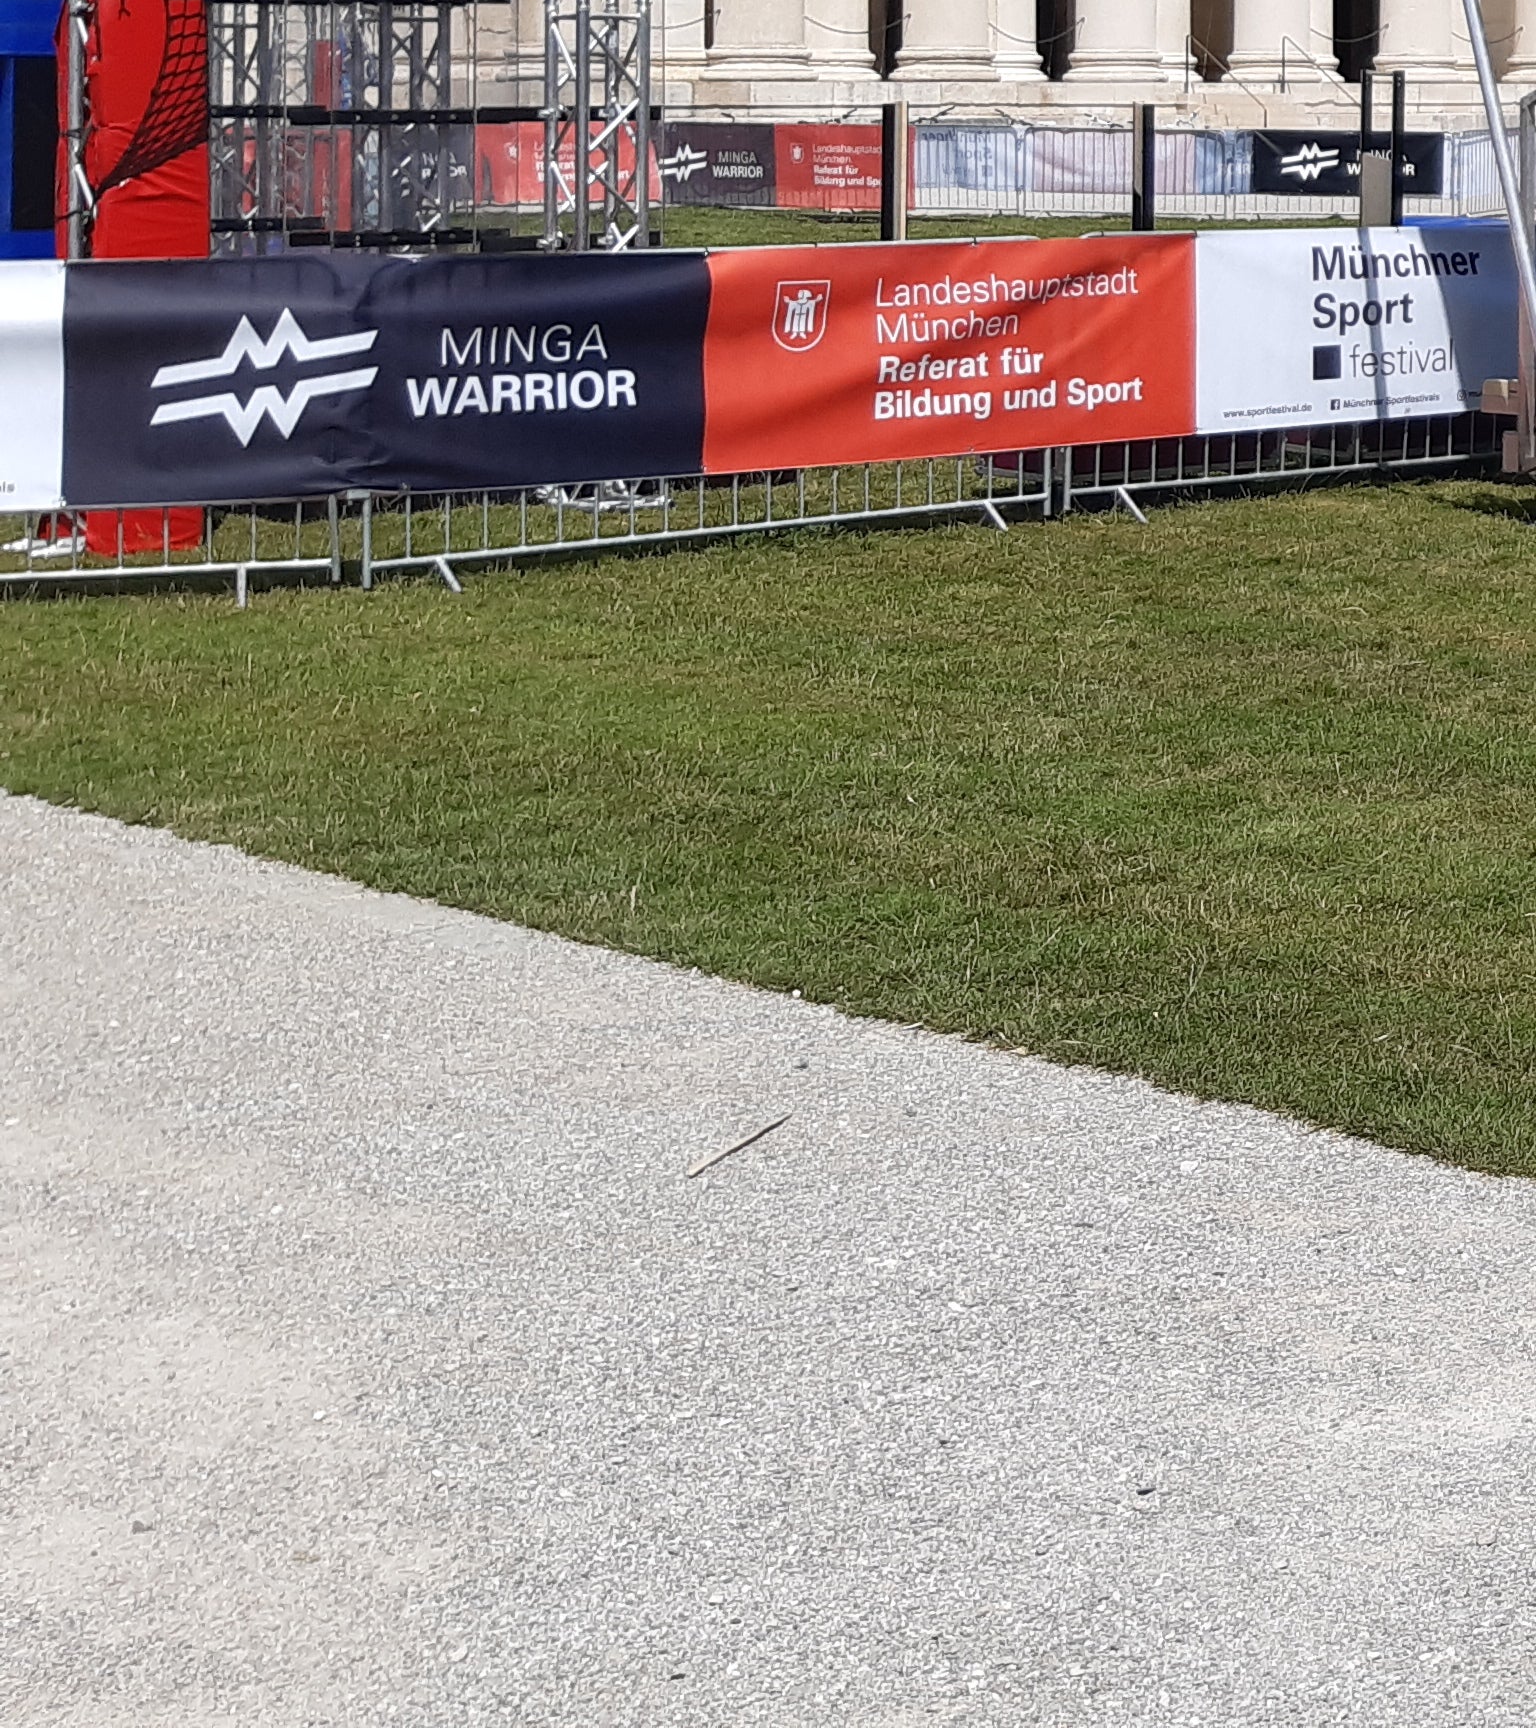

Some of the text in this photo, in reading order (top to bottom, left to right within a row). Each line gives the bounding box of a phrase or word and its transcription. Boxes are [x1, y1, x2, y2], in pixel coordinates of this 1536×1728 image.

[712, 165, 764, 178] WARRIOR
[718, 150, 757, 164] MINGA
[1311, 244, 1480, 281] Münchner
[875, 266, 1138, 307] Landeshauptstadt
[876, 310, 1019, 344] München
[1312, 292, 1414, 335] Sport
[441, 324, 608, 367] MINGA
[1349, 338, 1453, 378] festival
[878, 347, 1044, 383] Referat für
[406, 369, 637, 418] WARRIOR
[874, 377, 1143, 419] Bildung und Sport
[1223, 403, 1313, 419] www.sportfestival.de
